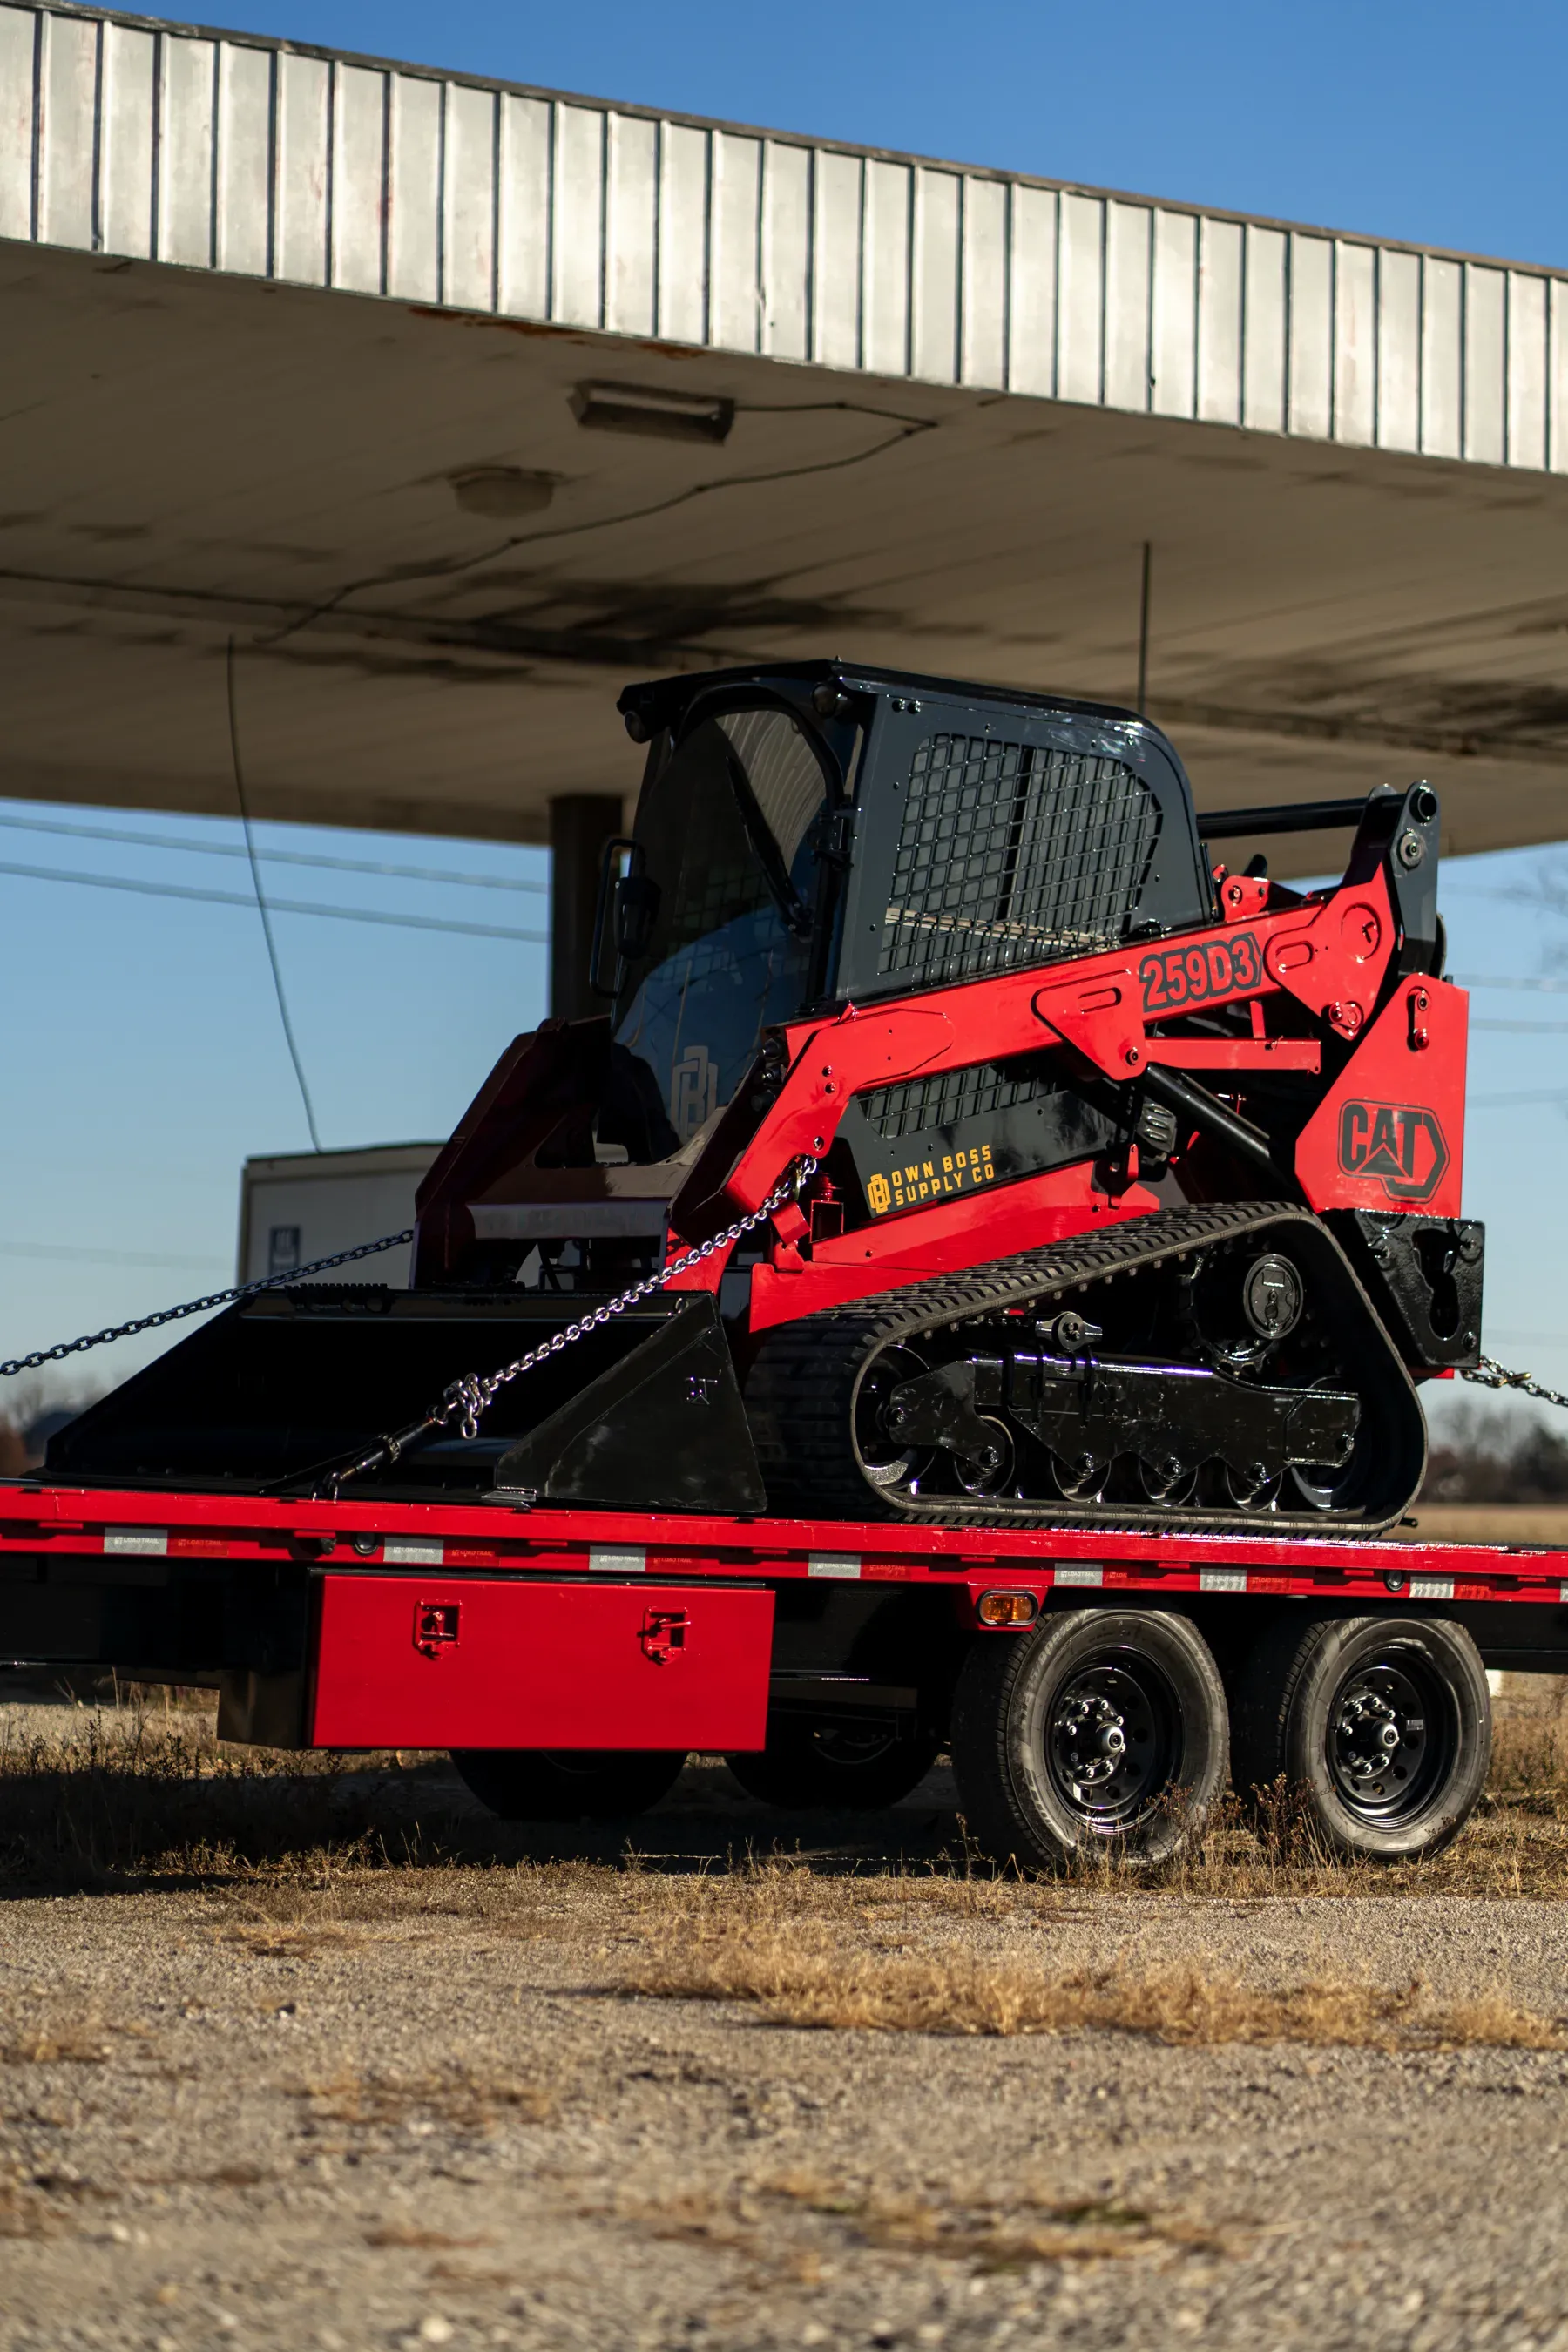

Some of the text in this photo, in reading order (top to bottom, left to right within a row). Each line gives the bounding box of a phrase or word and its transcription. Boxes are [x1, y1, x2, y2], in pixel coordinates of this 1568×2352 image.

[1140, 935, 1258, 1010] 259D3
[891, 1144, 992, 1186] OWN BOSS
[1342, 1104, 1423, 1178] CAT
[895, 1163, 995, 1206] SUPPLY CO
